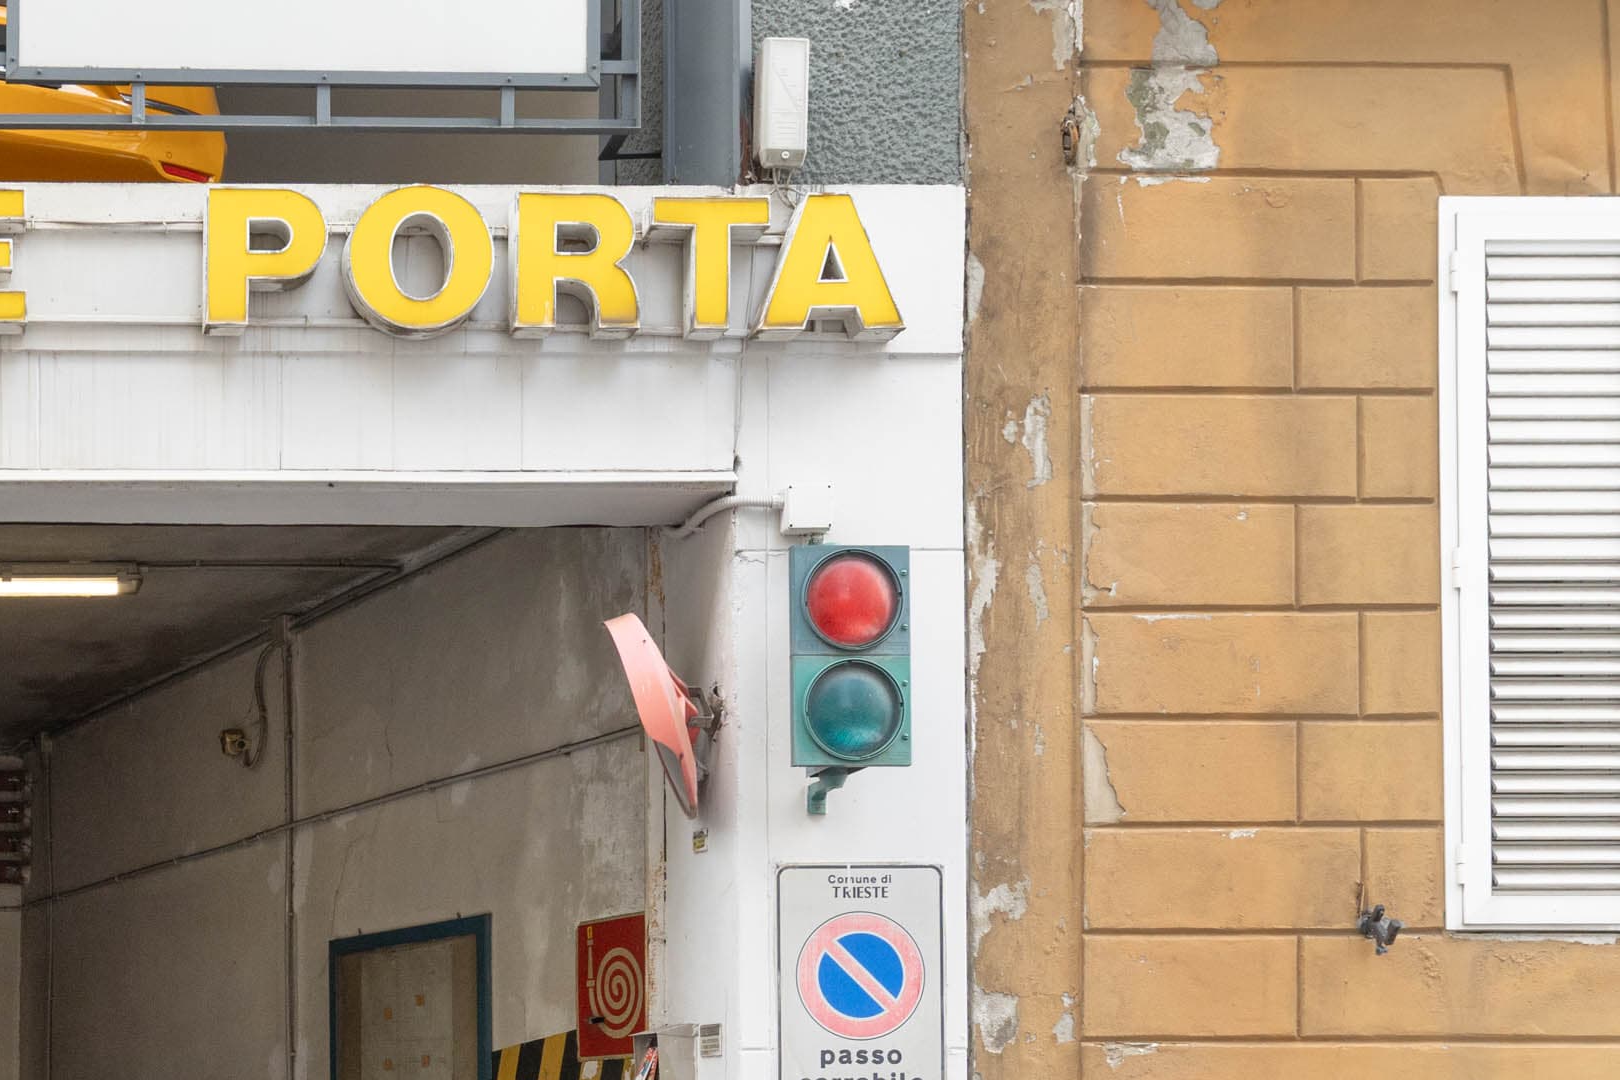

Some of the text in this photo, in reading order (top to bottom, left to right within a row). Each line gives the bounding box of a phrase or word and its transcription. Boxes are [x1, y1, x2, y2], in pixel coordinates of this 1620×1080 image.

[202, 184, 905, 341] PORTA
[827, 874, 892, 884] Comune di
[832, 886, 889, 899] TRIESTE
[820, 1049, 902, 1069] passo
